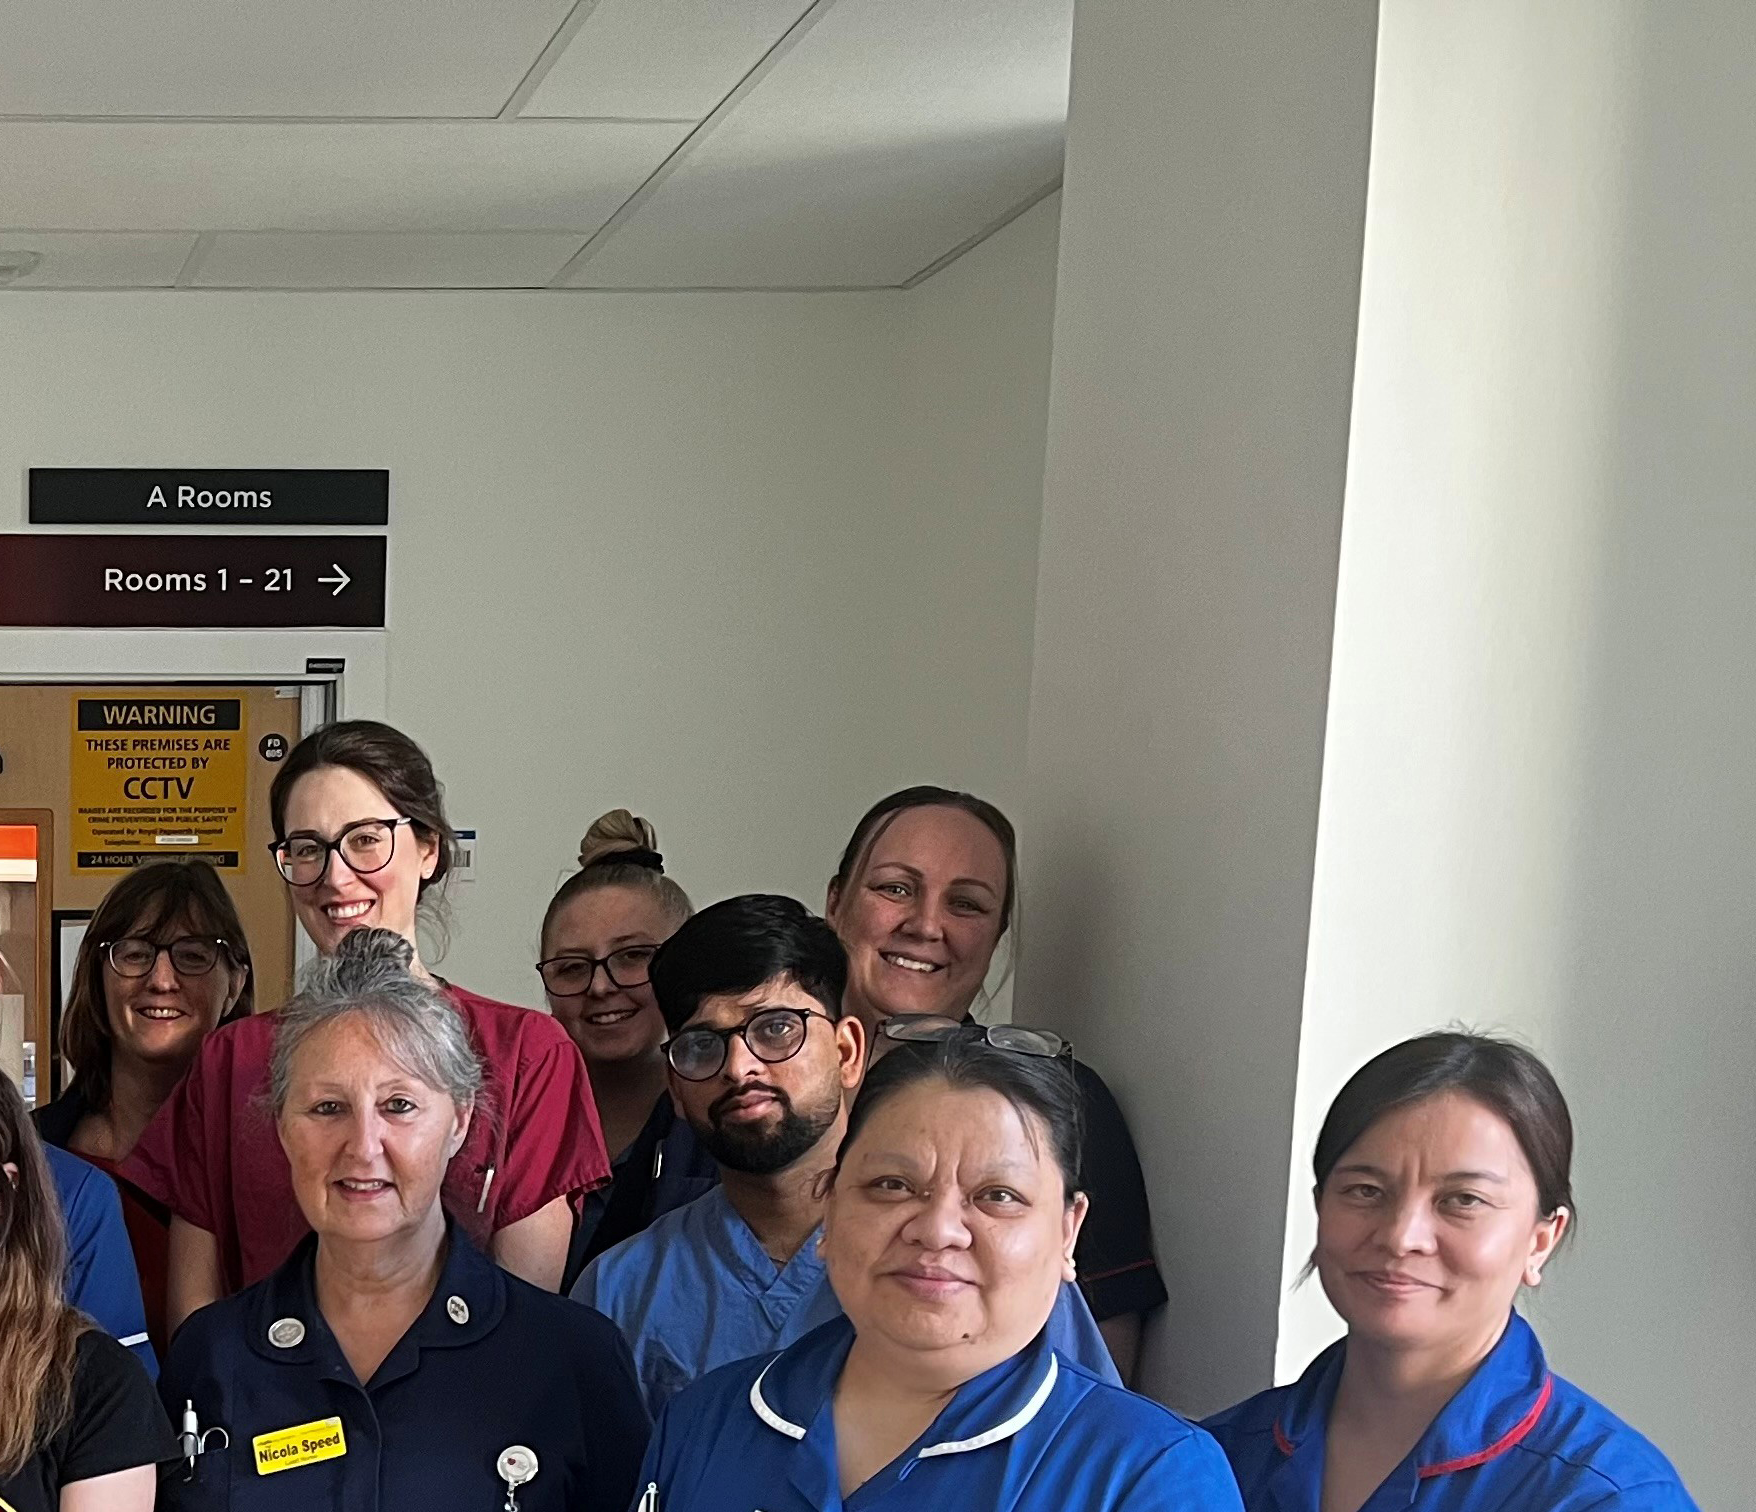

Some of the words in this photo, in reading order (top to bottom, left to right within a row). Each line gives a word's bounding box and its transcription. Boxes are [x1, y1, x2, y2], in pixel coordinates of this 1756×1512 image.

[146, 485, 167, 508] A
[177, 485, 272, 509] Rooms
[104, 568, 207, 592] Rooms
[217, 568, 228, 591] 1
[264, 568, 293, 592] 21
[102, 704, 216, 725] WARNING
[86, 738, 128, 752] THESE
[132, 738, 200, 752] PREMISES
[203, 738, 231, 752] ARE
[107, 756, 187, 770] PROTECTED
[191, 756, 209, 770] BY
[123, 776, 194, 800] CCTV
[91, 855, 103, 864] 24
[105, 855, 133, 865] HOUR
[259, 1444, 298, 1463] Nicola
[301, 1431, 340, 1454] Speed
